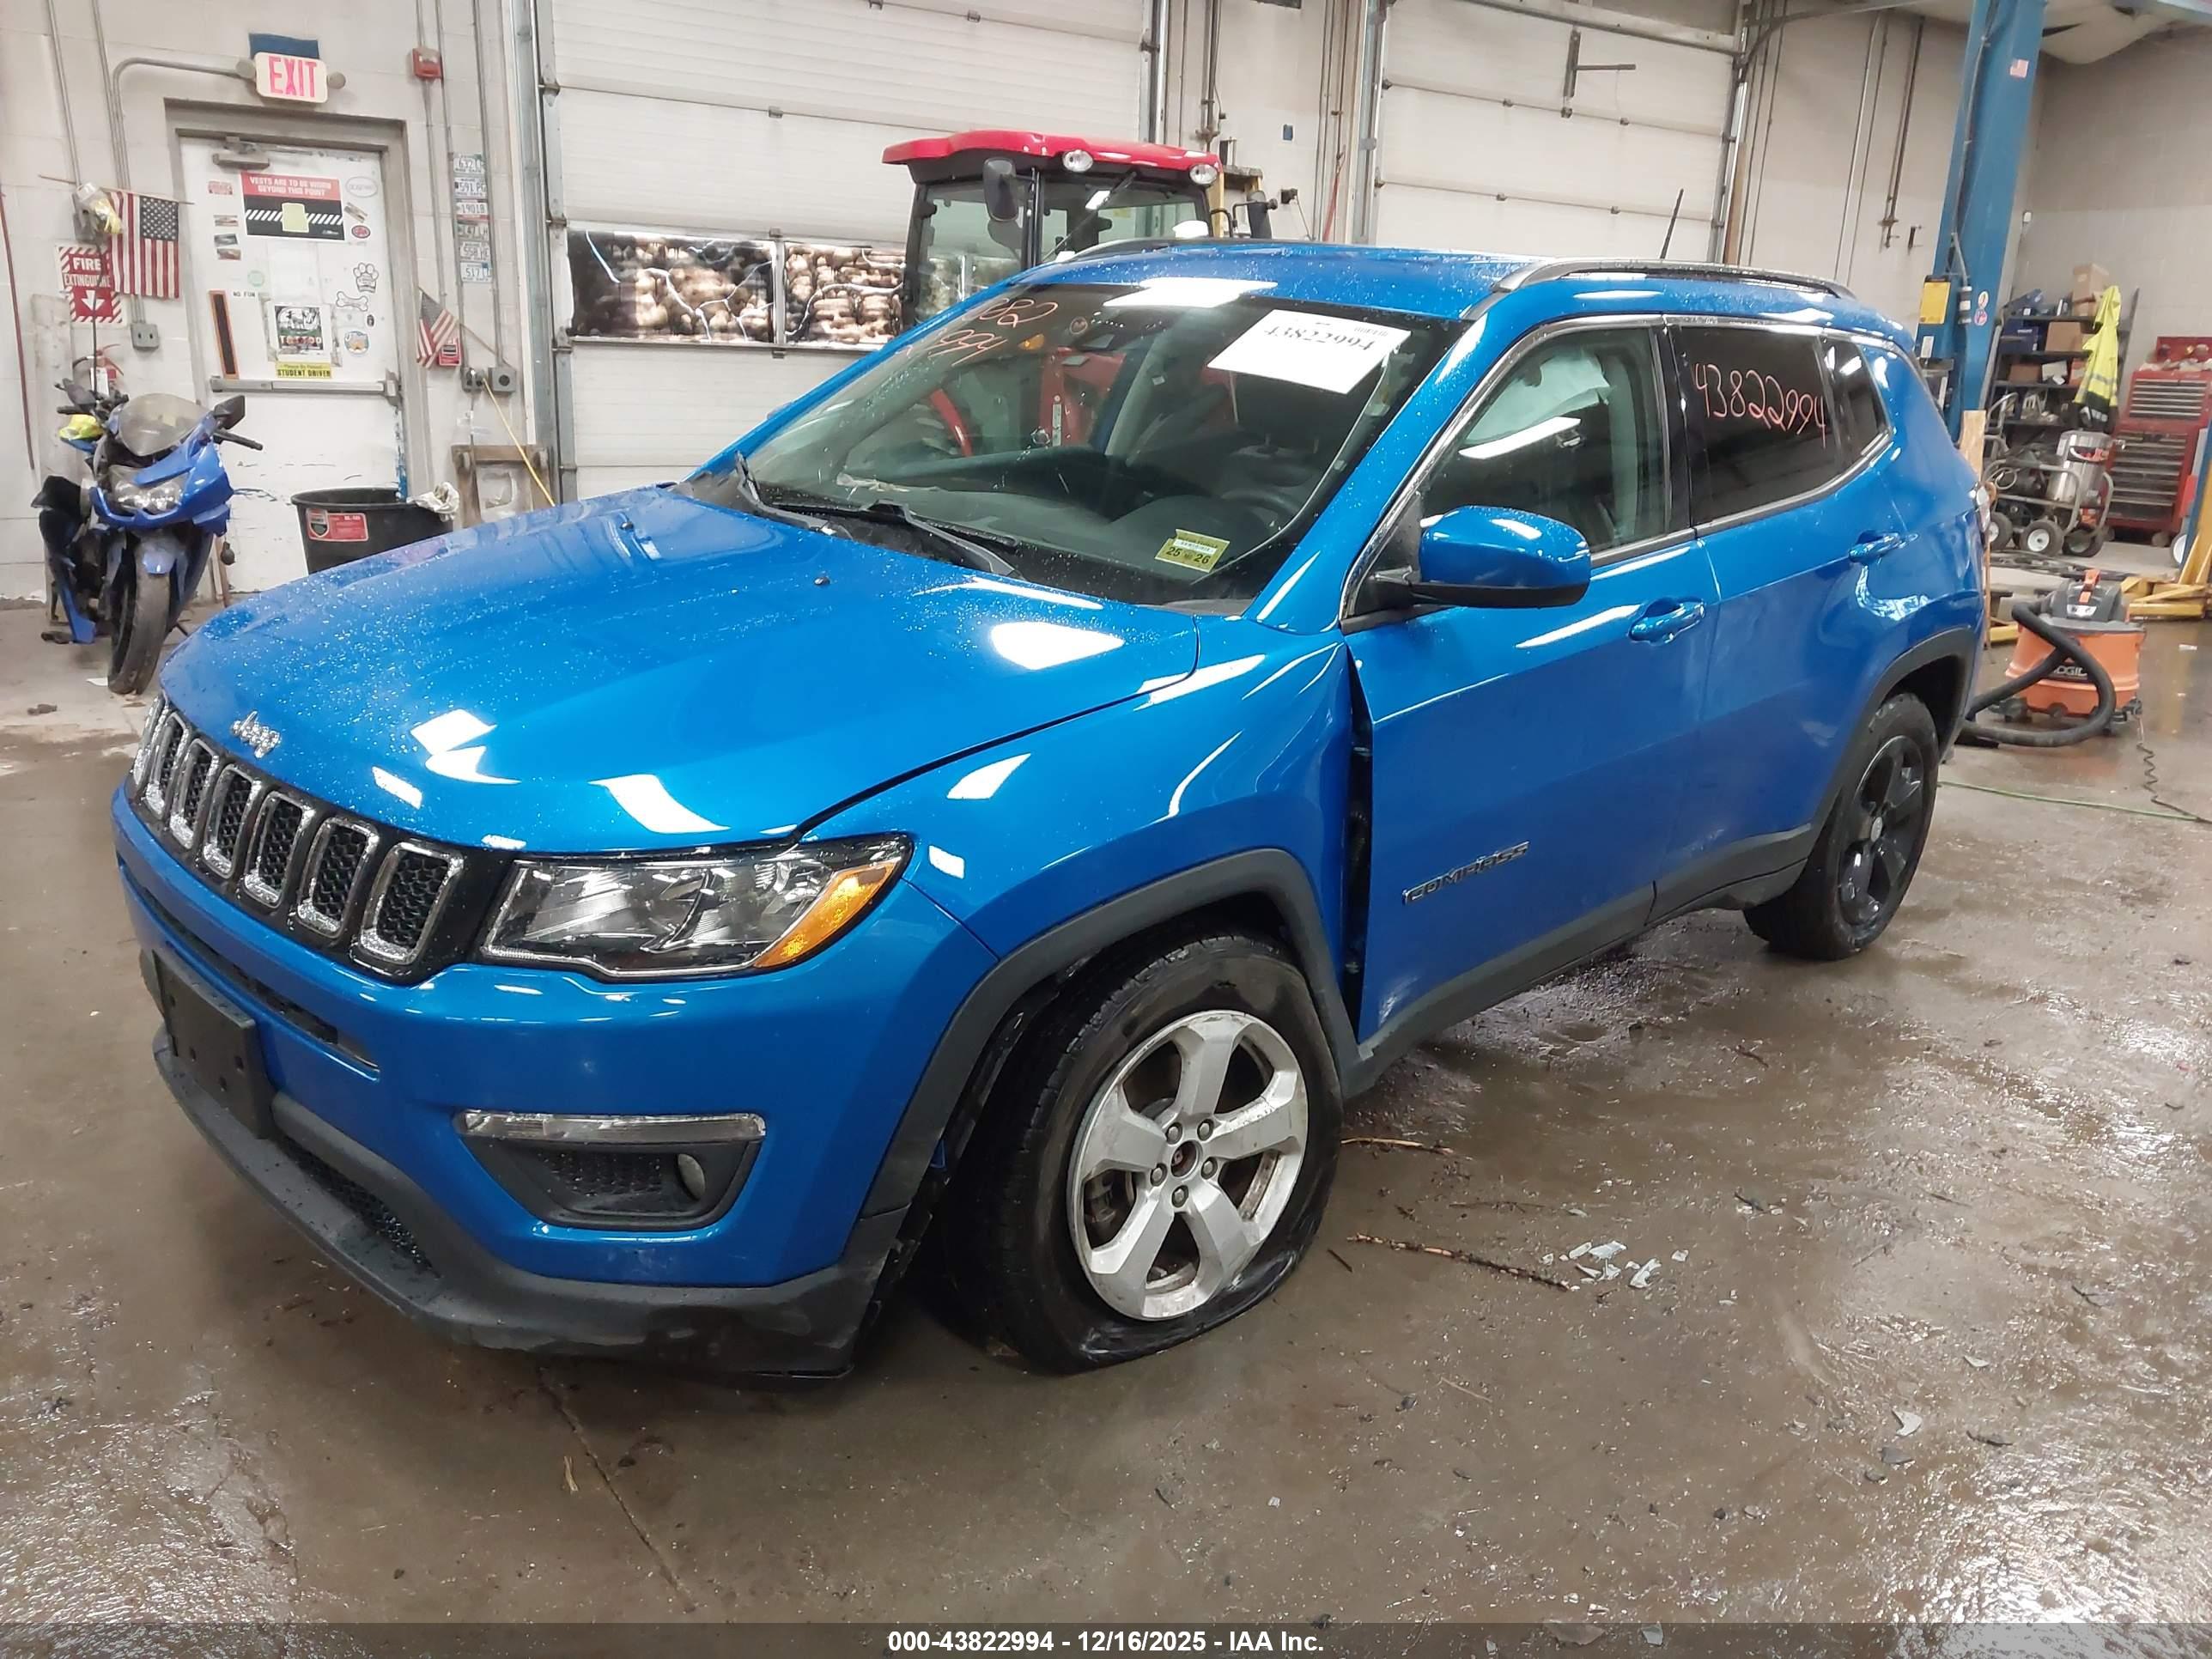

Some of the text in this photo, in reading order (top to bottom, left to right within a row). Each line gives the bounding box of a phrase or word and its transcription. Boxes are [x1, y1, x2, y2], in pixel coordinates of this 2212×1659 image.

[269, 55, 317, 98] EXIT
[249, 176, 272, 185] VESTS
[274, 178, 288, 186] ARE
[289, 179, 299, 187] TO
[300, 179, 309, 188] BE
[258, 185, 326, 196] BEYOND THIS POINT
[73, 257, 101, 270] FIRE
[1694, 363, 1826, 449] 43822994
[1166, 547, 1182, 556] 25
[1193, 553, 1211, 563] 26
